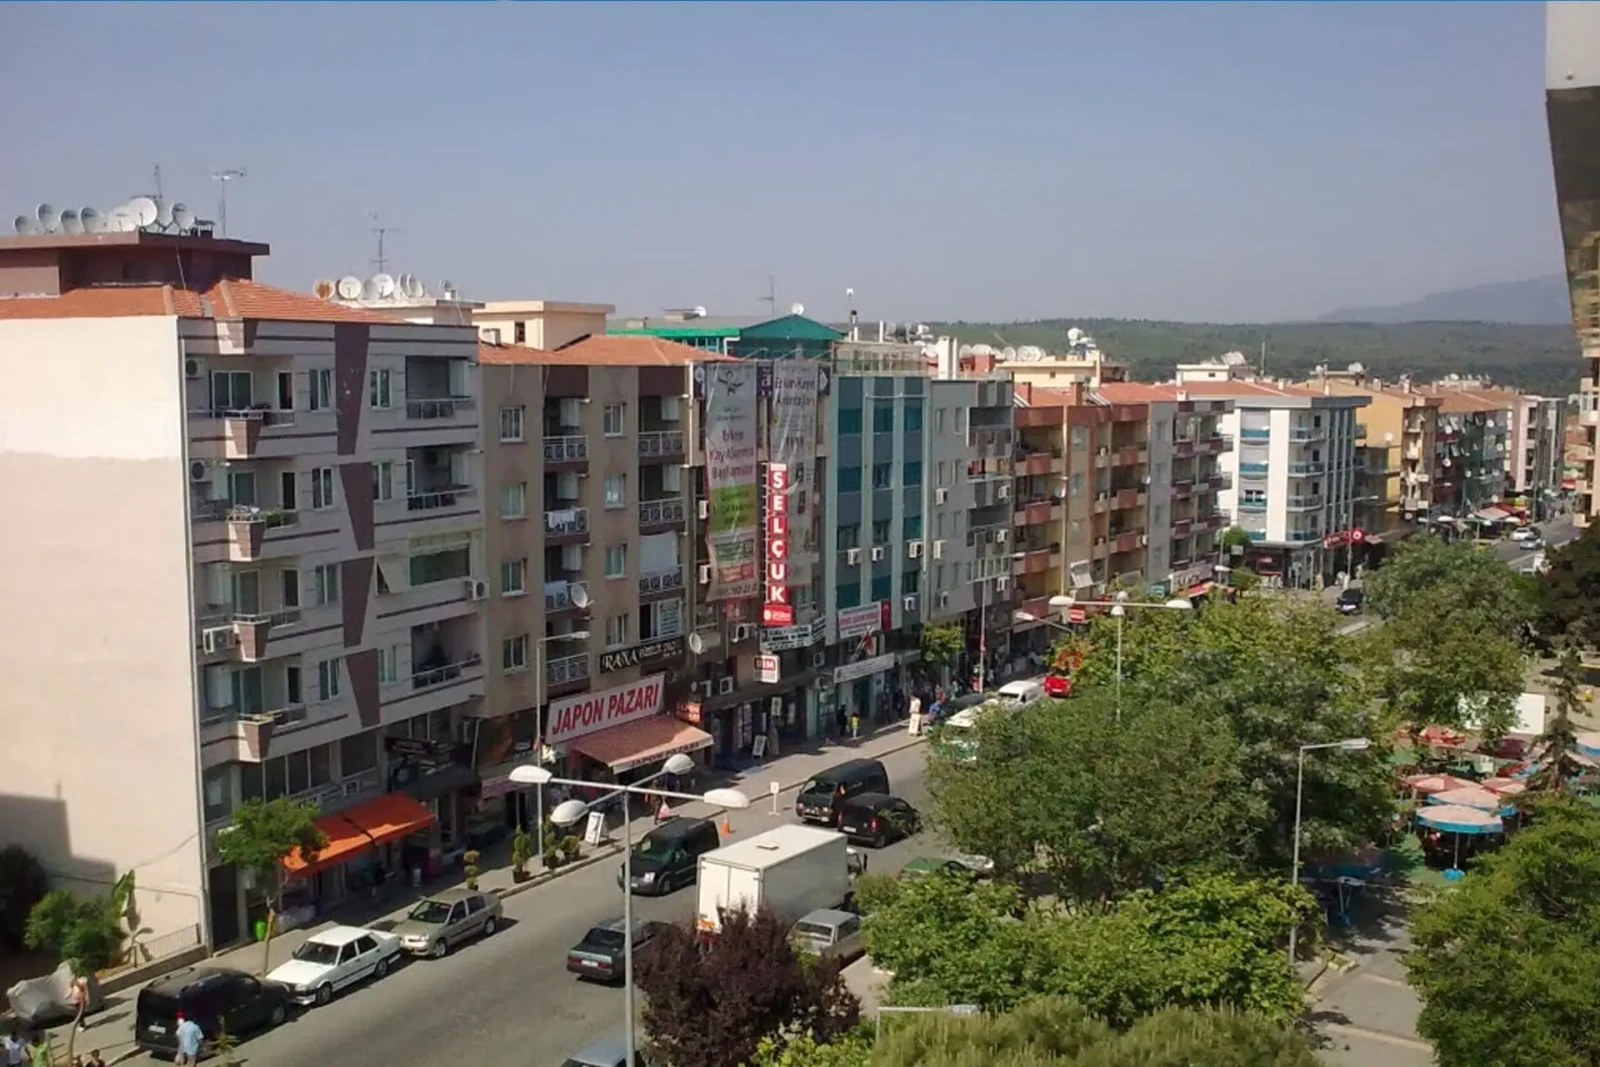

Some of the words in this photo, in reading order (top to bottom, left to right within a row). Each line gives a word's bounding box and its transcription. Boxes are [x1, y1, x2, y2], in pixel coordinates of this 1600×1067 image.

[771, 471, 786, 603] SELÇUK
[552, 698, 603, 734] JAPON
[607, 684, 659, 718] PAZARI
